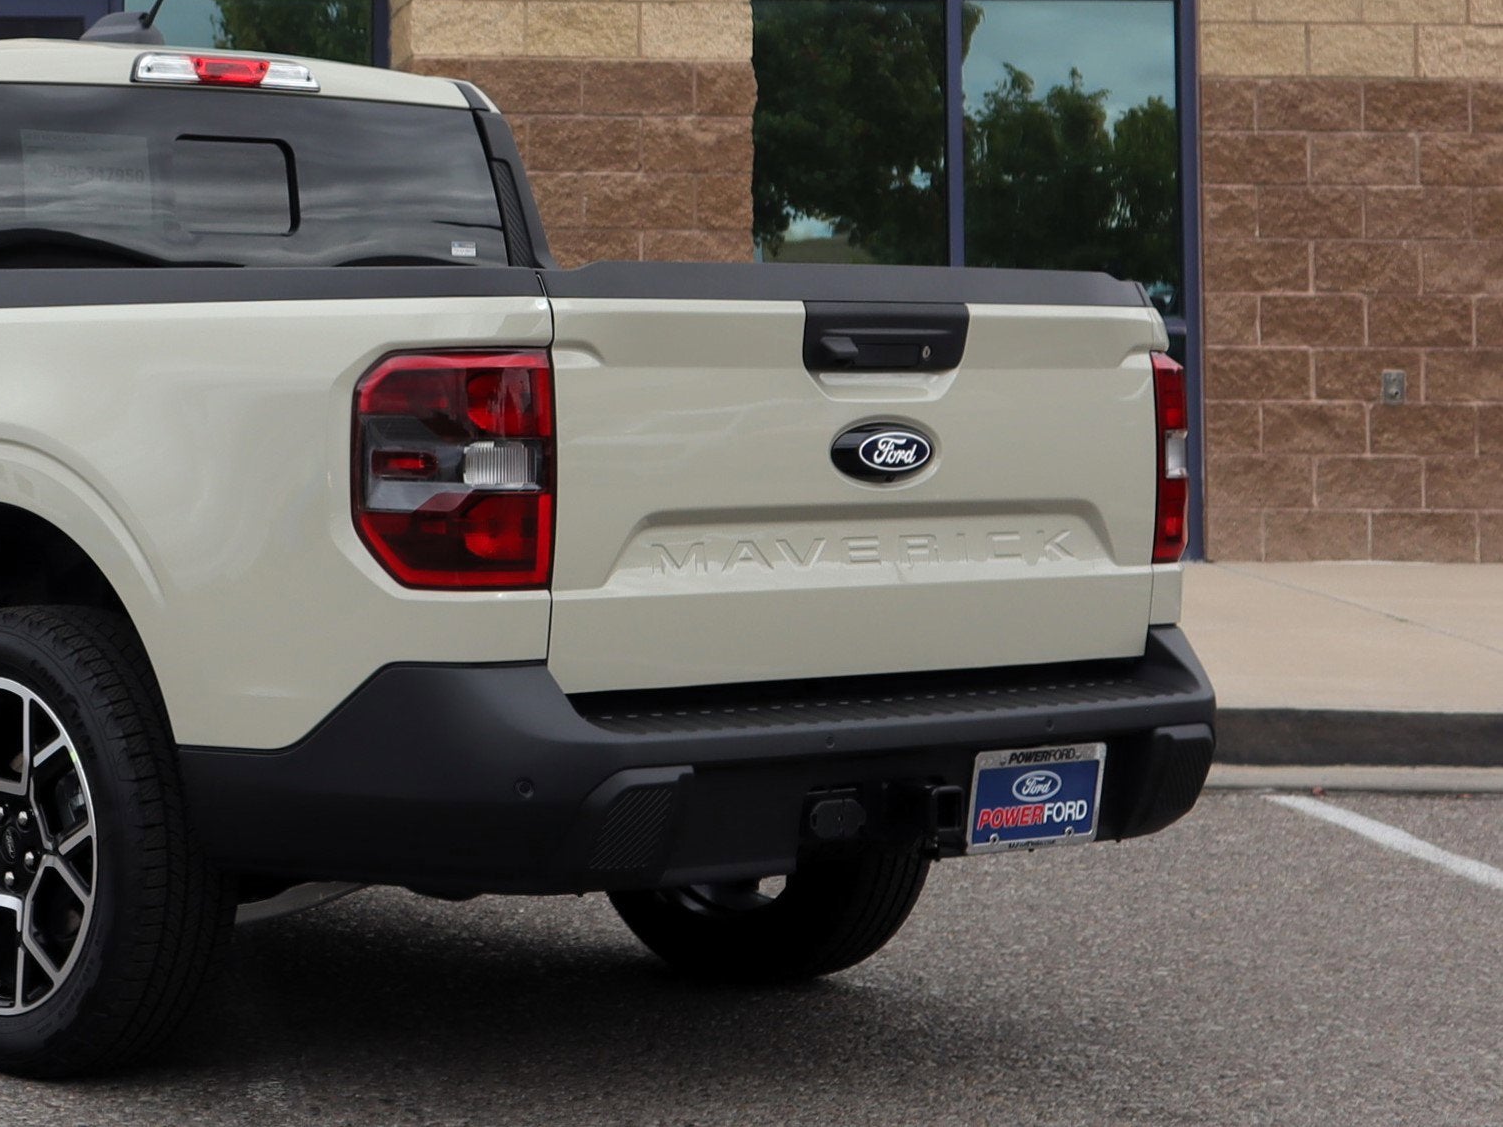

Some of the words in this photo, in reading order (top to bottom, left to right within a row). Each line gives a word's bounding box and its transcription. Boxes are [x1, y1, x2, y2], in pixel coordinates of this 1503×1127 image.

[873, 437, 918, 464] Ford
[650, 528, 1076, 576] MAVERICK
[1008, 748, 1076, 765] POWERFORD
[1022, 776, 1051, 795] Ford
[976, 799, 1088, 831] POWERFORD
